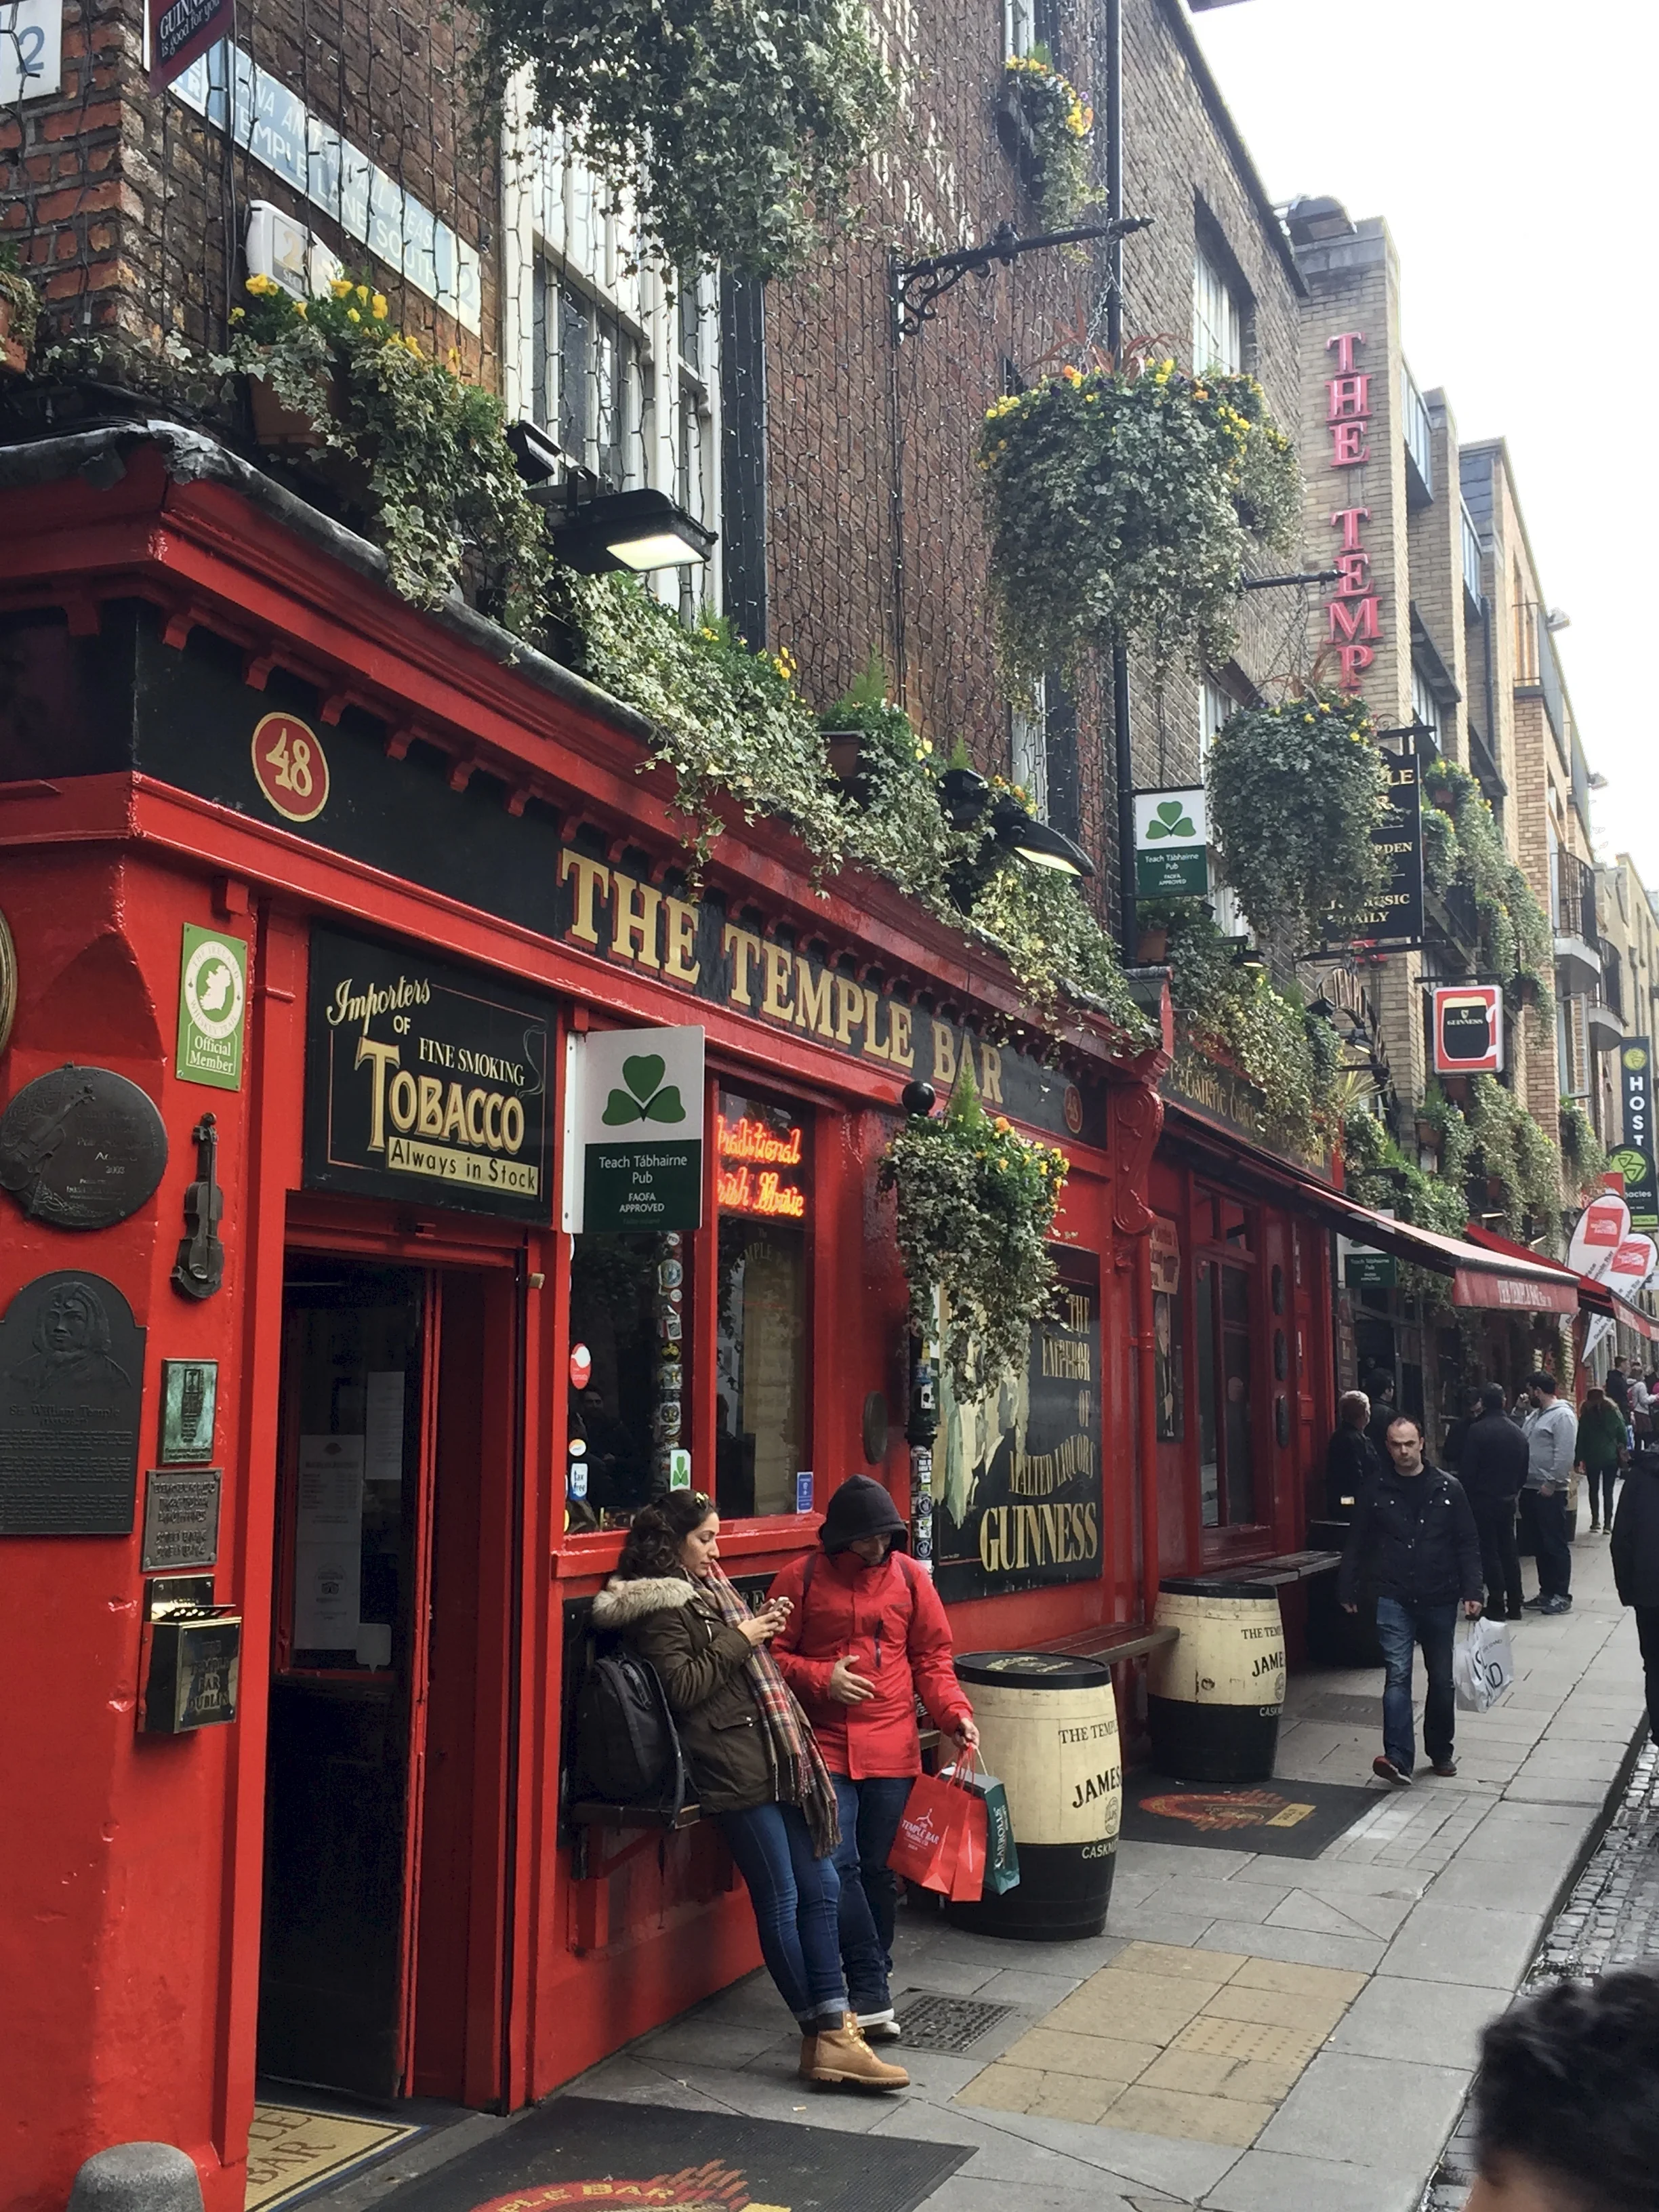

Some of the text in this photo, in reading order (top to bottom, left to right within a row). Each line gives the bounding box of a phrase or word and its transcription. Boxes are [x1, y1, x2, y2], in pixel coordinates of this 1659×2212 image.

[16, 26, 45, 74] 2
[169, 17, 190, 56] good
[190, 9, 203, 29] for
[281, 105, 306, 141] AN
[316, 167, 368, 232] LANE
[375, 218, 436, 283] SOUTH
[1323, 331, 1372, 468] THE
[265, 727, 313, 798] 48
[1145, 855, 1164, 863] Teach
[1166, 863, 1179, 871] Pub
[207, 945, 240, 979] IRELAND
[561, 848, 1005, 1105] THE TEMPLE BAR
[326, 975, 432, 1037] Importers
[392, 1015, 411, 1036] OF
[189, 1049, 234, 1073] Member
[194, 1035, 231, 1057] Official
[418, 1036, 526, 1087] FINE SMOKING
[354, 1036, 526, 1155] TOBACCO
[390, 1139, 536, 1191] Always in Stock
[598, 1153, 688, 1169] Teach Tábhairne
[632, 1170, 653, 1185] Pub
[619, 1203, 665, 1213] APPROVED
[628, 1191, 657, 1202] FAOFA
[1069, 1293, 1090, 1335] THE
[1042, 1336, 1091, 1382] EMPEROR
[79, 1404, 121, 1419] Temple
[1079, 1389, 1091, 1428] OF
[1008, 1433, 1096, 1496] MALTED LIQUORS
[979, 1501, 1099, 1572] GUINNESS
[1240, 1627, 1263, 1639] THE
[189, 1690, 230, 1710] DUBLIN
[198, 1676, 221, 1692] BAR
[1059, 1726, 1088, 1744] THE
[901, 1819, 940, 1845] TEMPLE BAR
[247, 2140, 337, 2186] BAR
[582, 2184, 674, 2200] BAR
